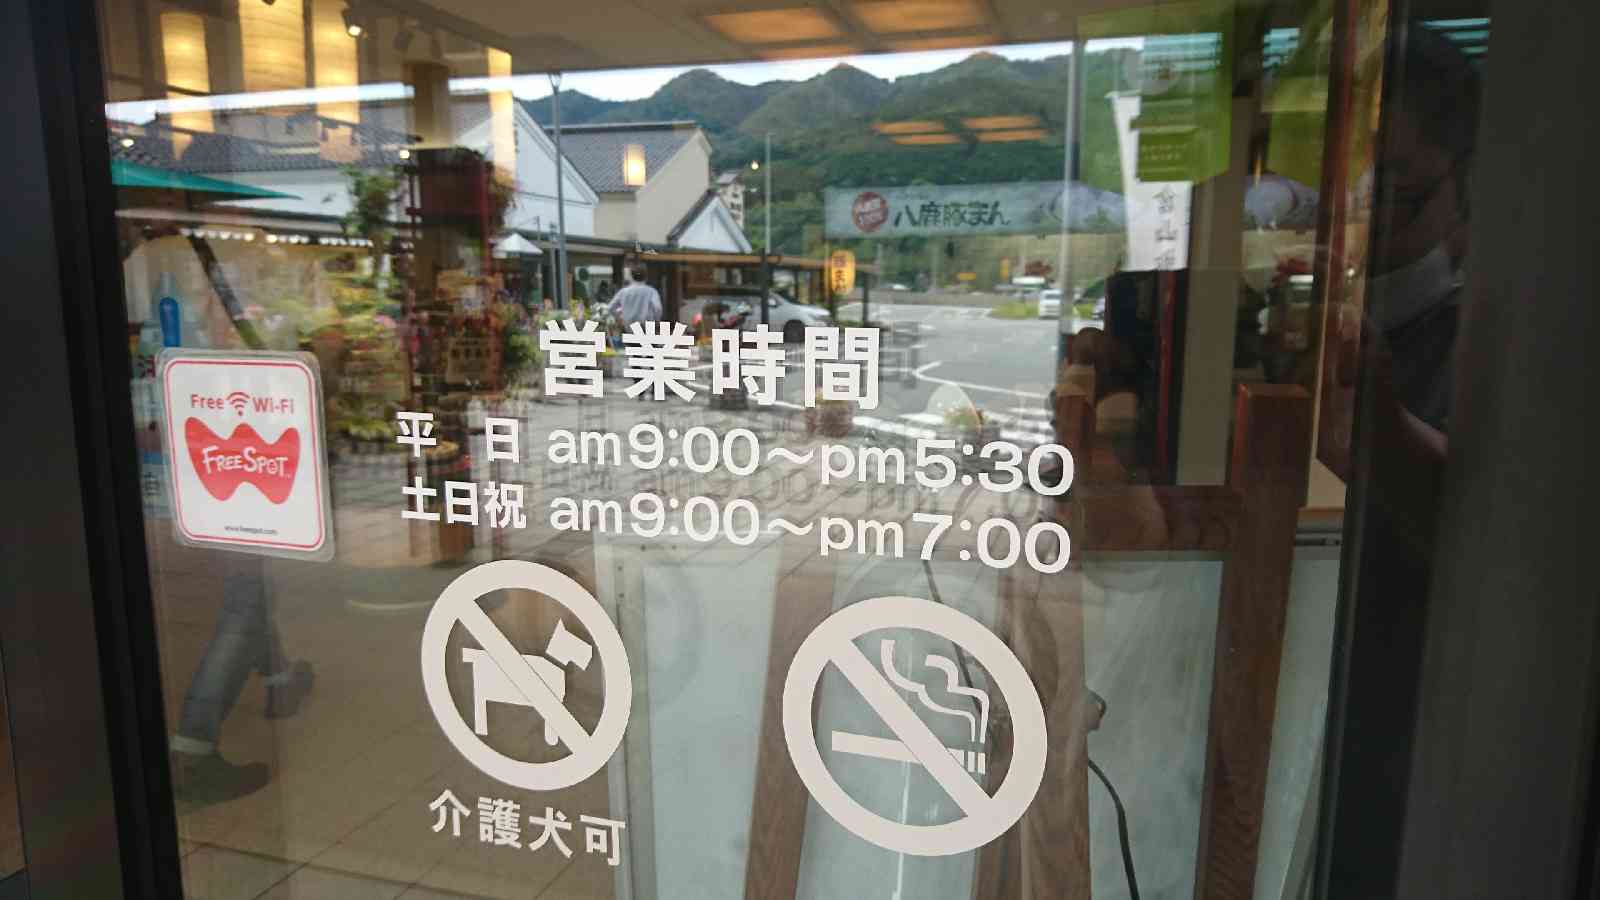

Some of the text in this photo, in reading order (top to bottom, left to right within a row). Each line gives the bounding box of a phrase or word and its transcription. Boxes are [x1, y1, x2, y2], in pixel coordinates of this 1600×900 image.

[539, 319, 881, 410] 営業時間
[190, 393, 295, 415] Free Wi-Fi
[400, 476, 528, 529] 土日祝
[428, 788, 626, 867] 介護犬可
